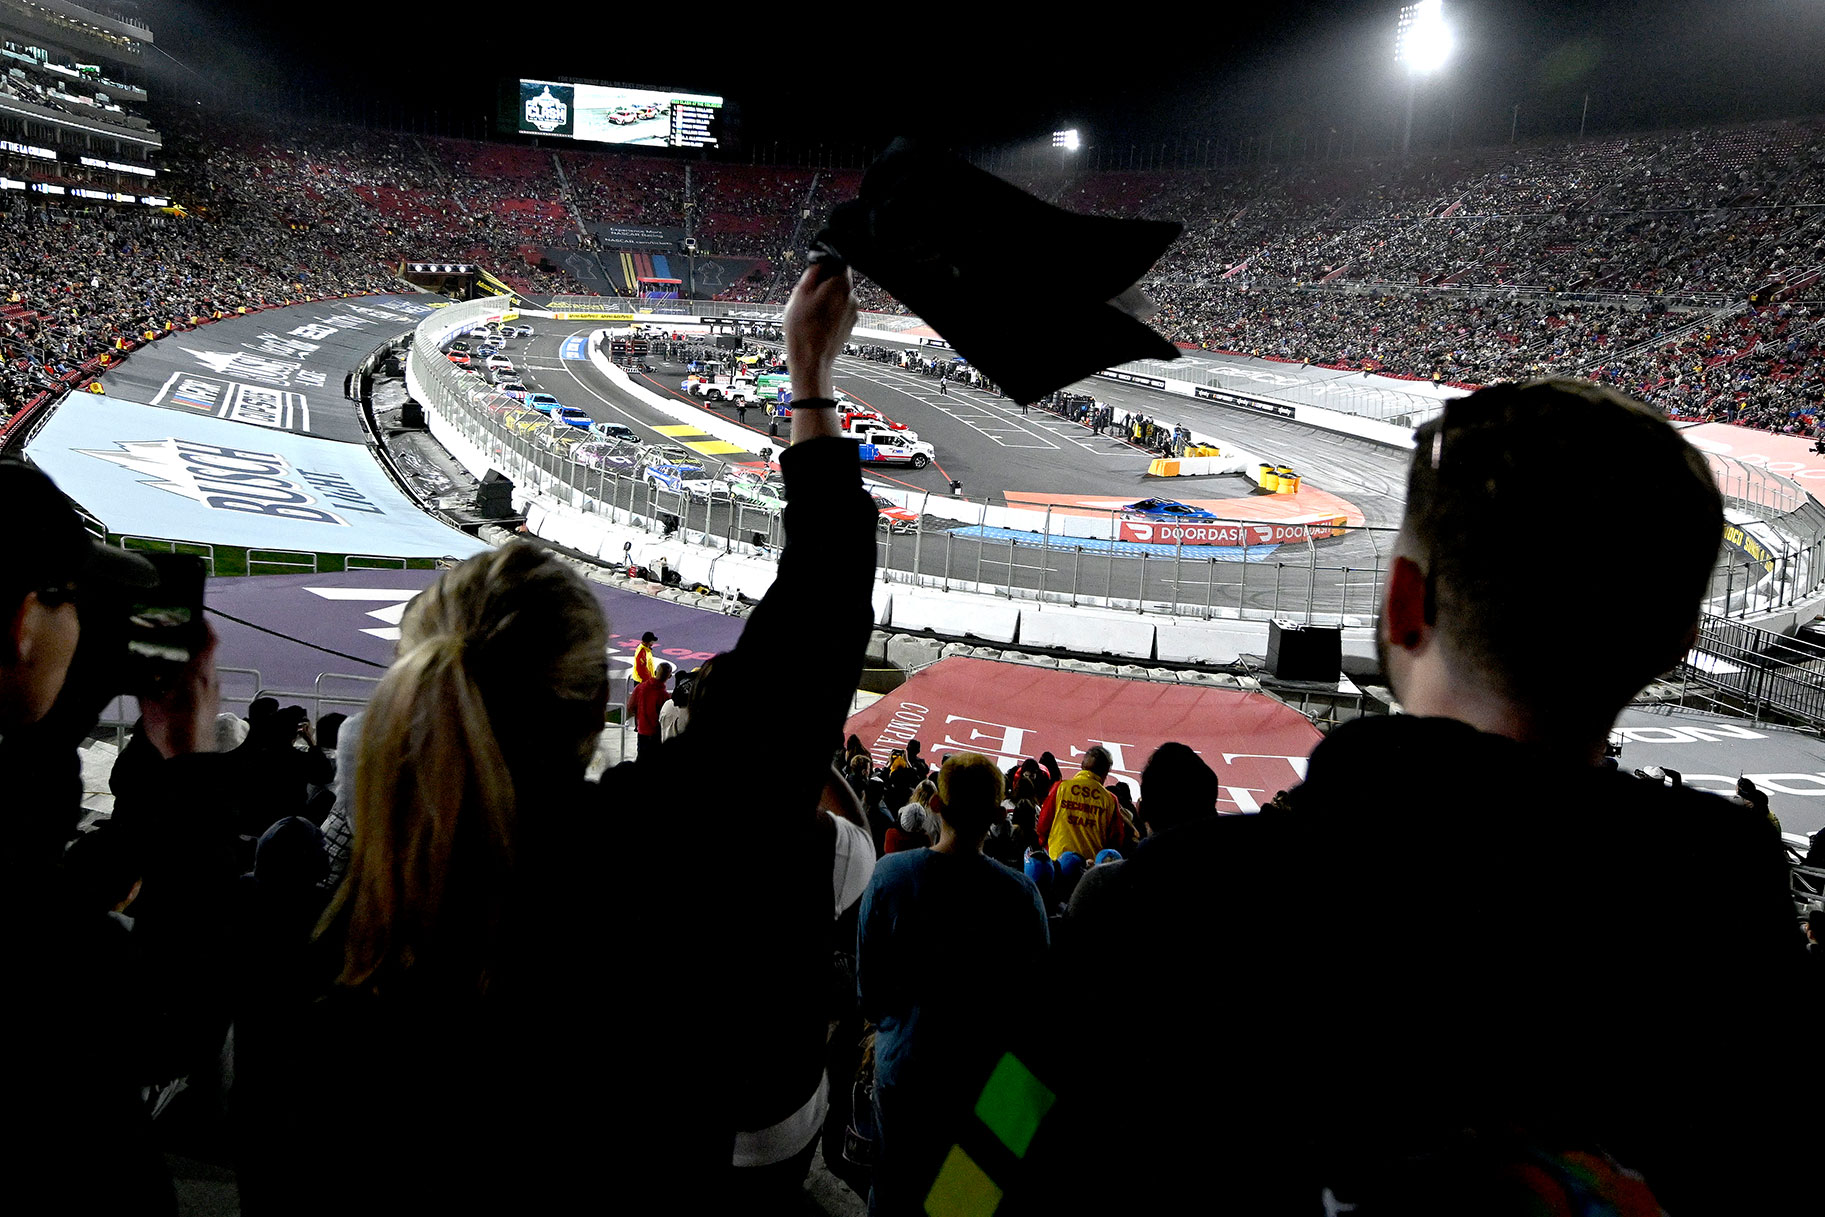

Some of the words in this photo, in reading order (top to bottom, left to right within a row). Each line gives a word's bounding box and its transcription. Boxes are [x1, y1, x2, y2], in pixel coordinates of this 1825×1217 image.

[174, 438, 342, 525] BUSCH
[295, 468, 387, 515] LIGHT
[1161, 527, 1248, 541] DOORDASH
[1071, 784, 1101, 800] CSC
[1061, 799, 1108, 817] SECURITY
[1067, 815, 1098, 828] STAFF
